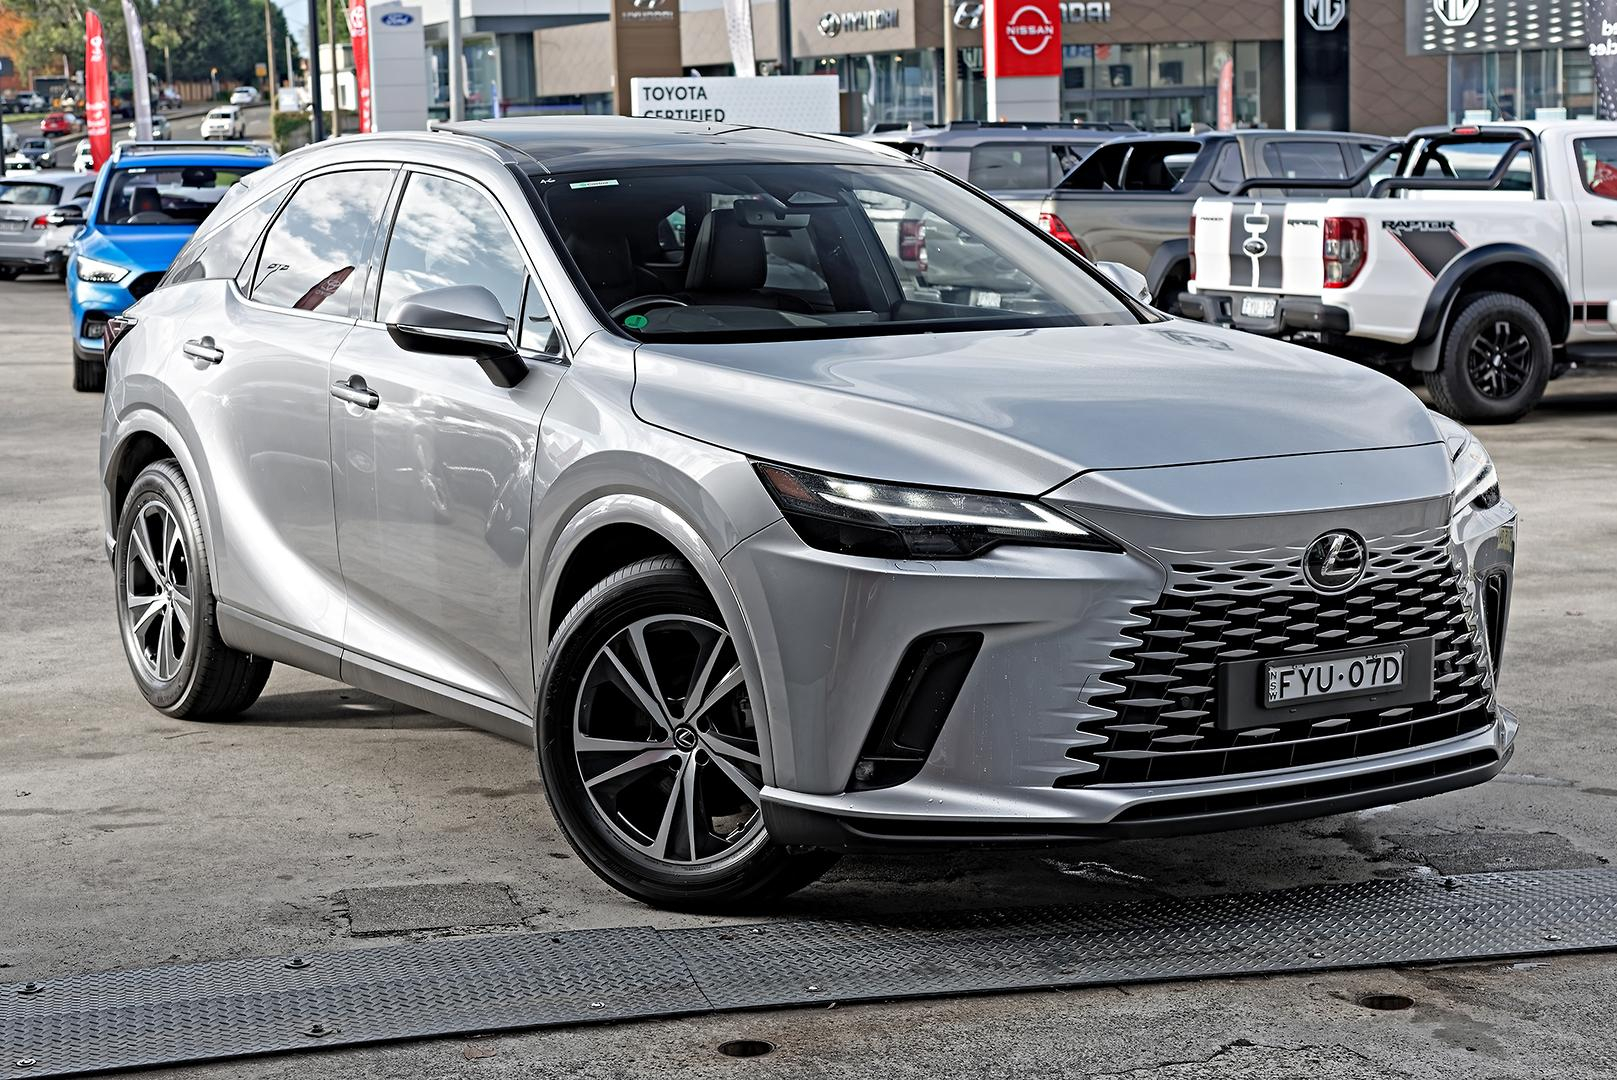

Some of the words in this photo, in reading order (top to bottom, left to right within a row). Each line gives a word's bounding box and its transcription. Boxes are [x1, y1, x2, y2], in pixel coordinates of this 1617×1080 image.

[841, 8, 899, 32] HYUNDAI
[1006, 25, 1054, 36] NISSAN
[643, 86, 708, 101] TOYOTA
[643, 108, 726, 123] CERTIFIED
[1382, 220, 1457, 232] RAPTOR
